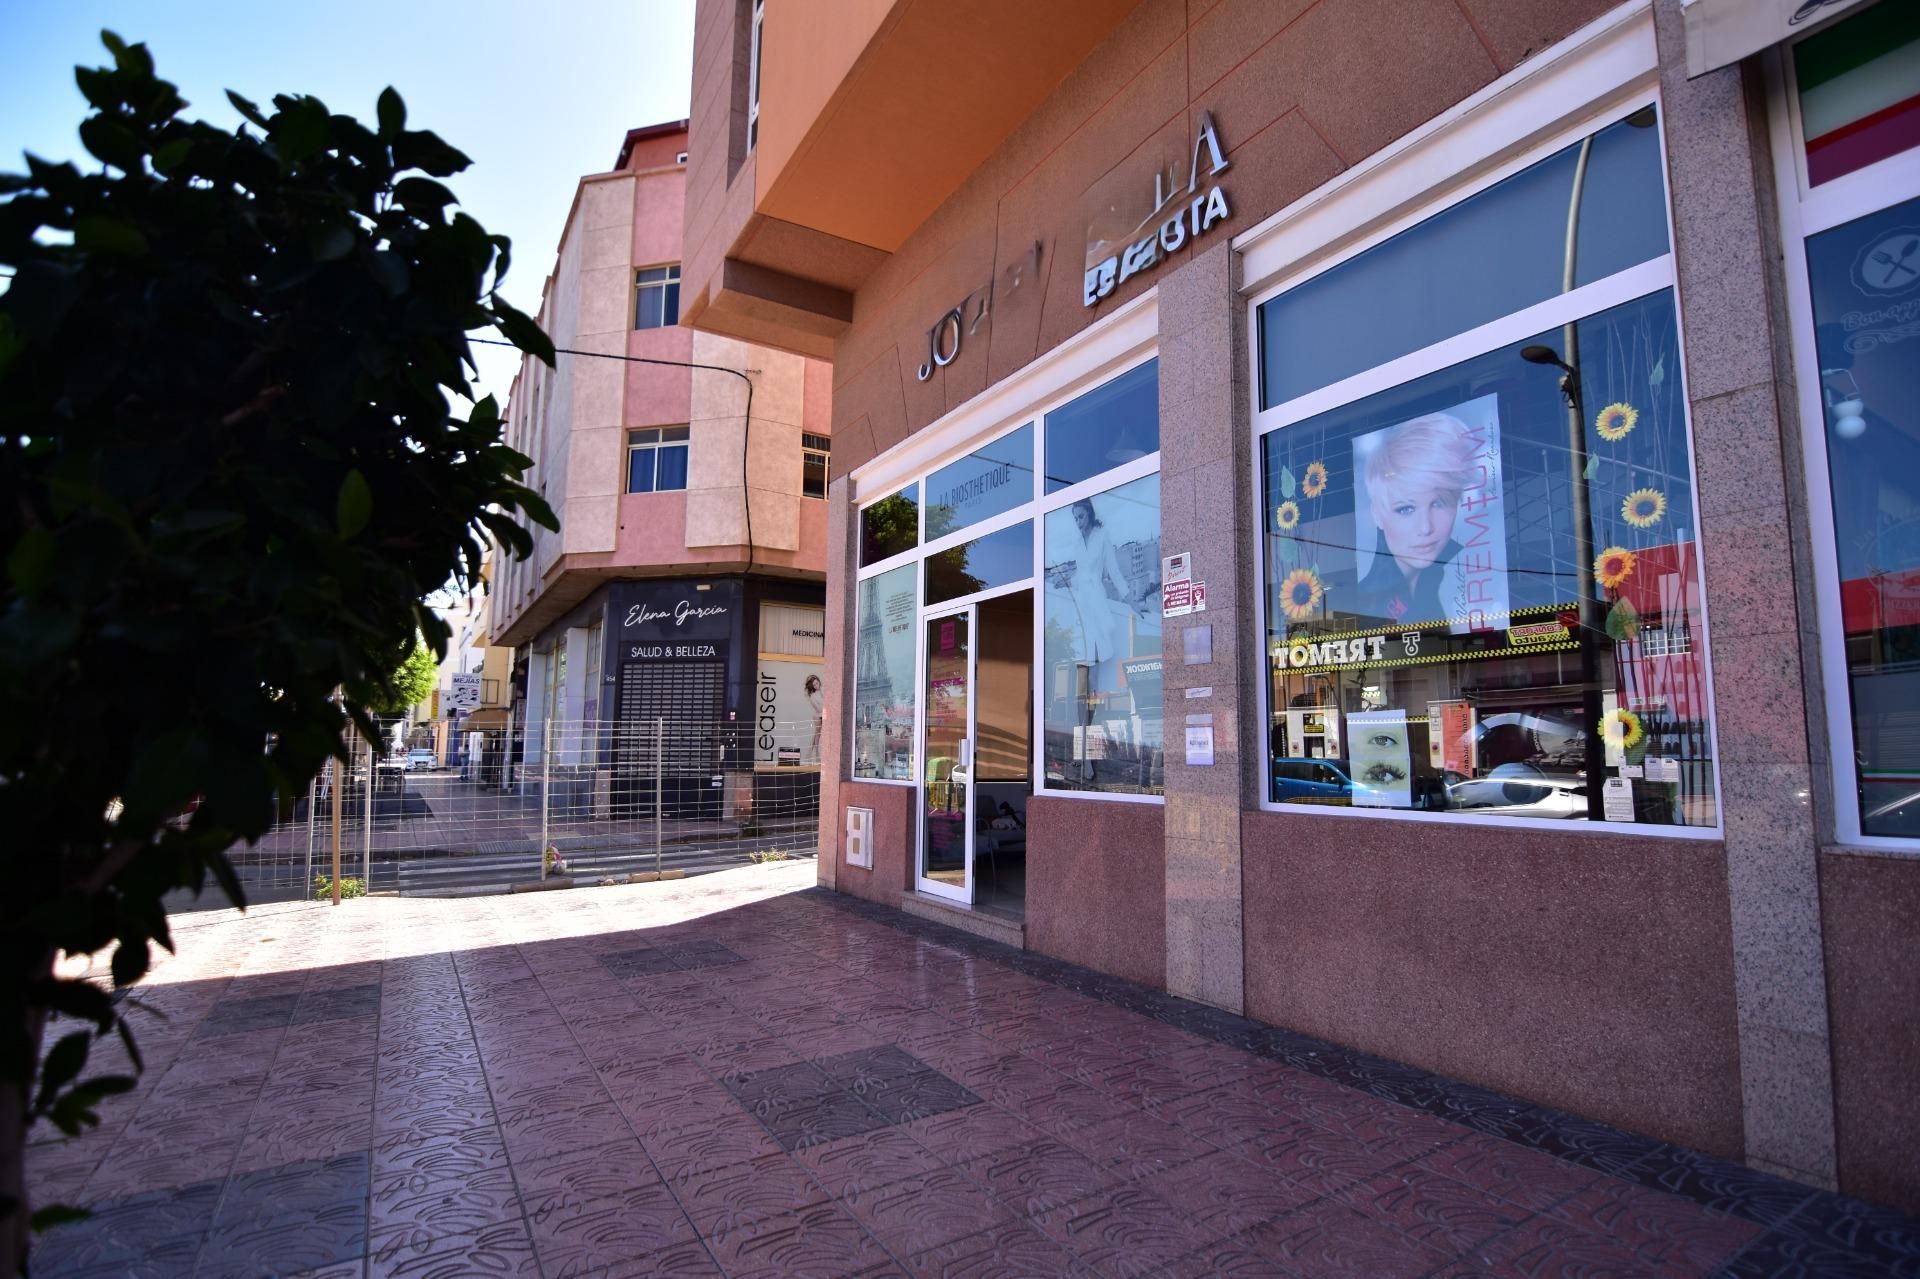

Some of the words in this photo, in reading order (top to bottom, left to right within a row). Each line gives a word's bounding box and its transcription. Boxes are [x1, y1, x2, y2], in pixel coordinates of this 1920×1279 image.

[951, 463, 1011, 506] BIOSTHETIQUE
[1165, 582, 1190, 593] Alarma
[624, 604, 671, 627] Elena
[631, 646, 662, 658] SALUD
[665, 647, 673, 657] &
[676, 646, 716, 657] BELLEZA
[757, 671, 777, 762] Leaseir
